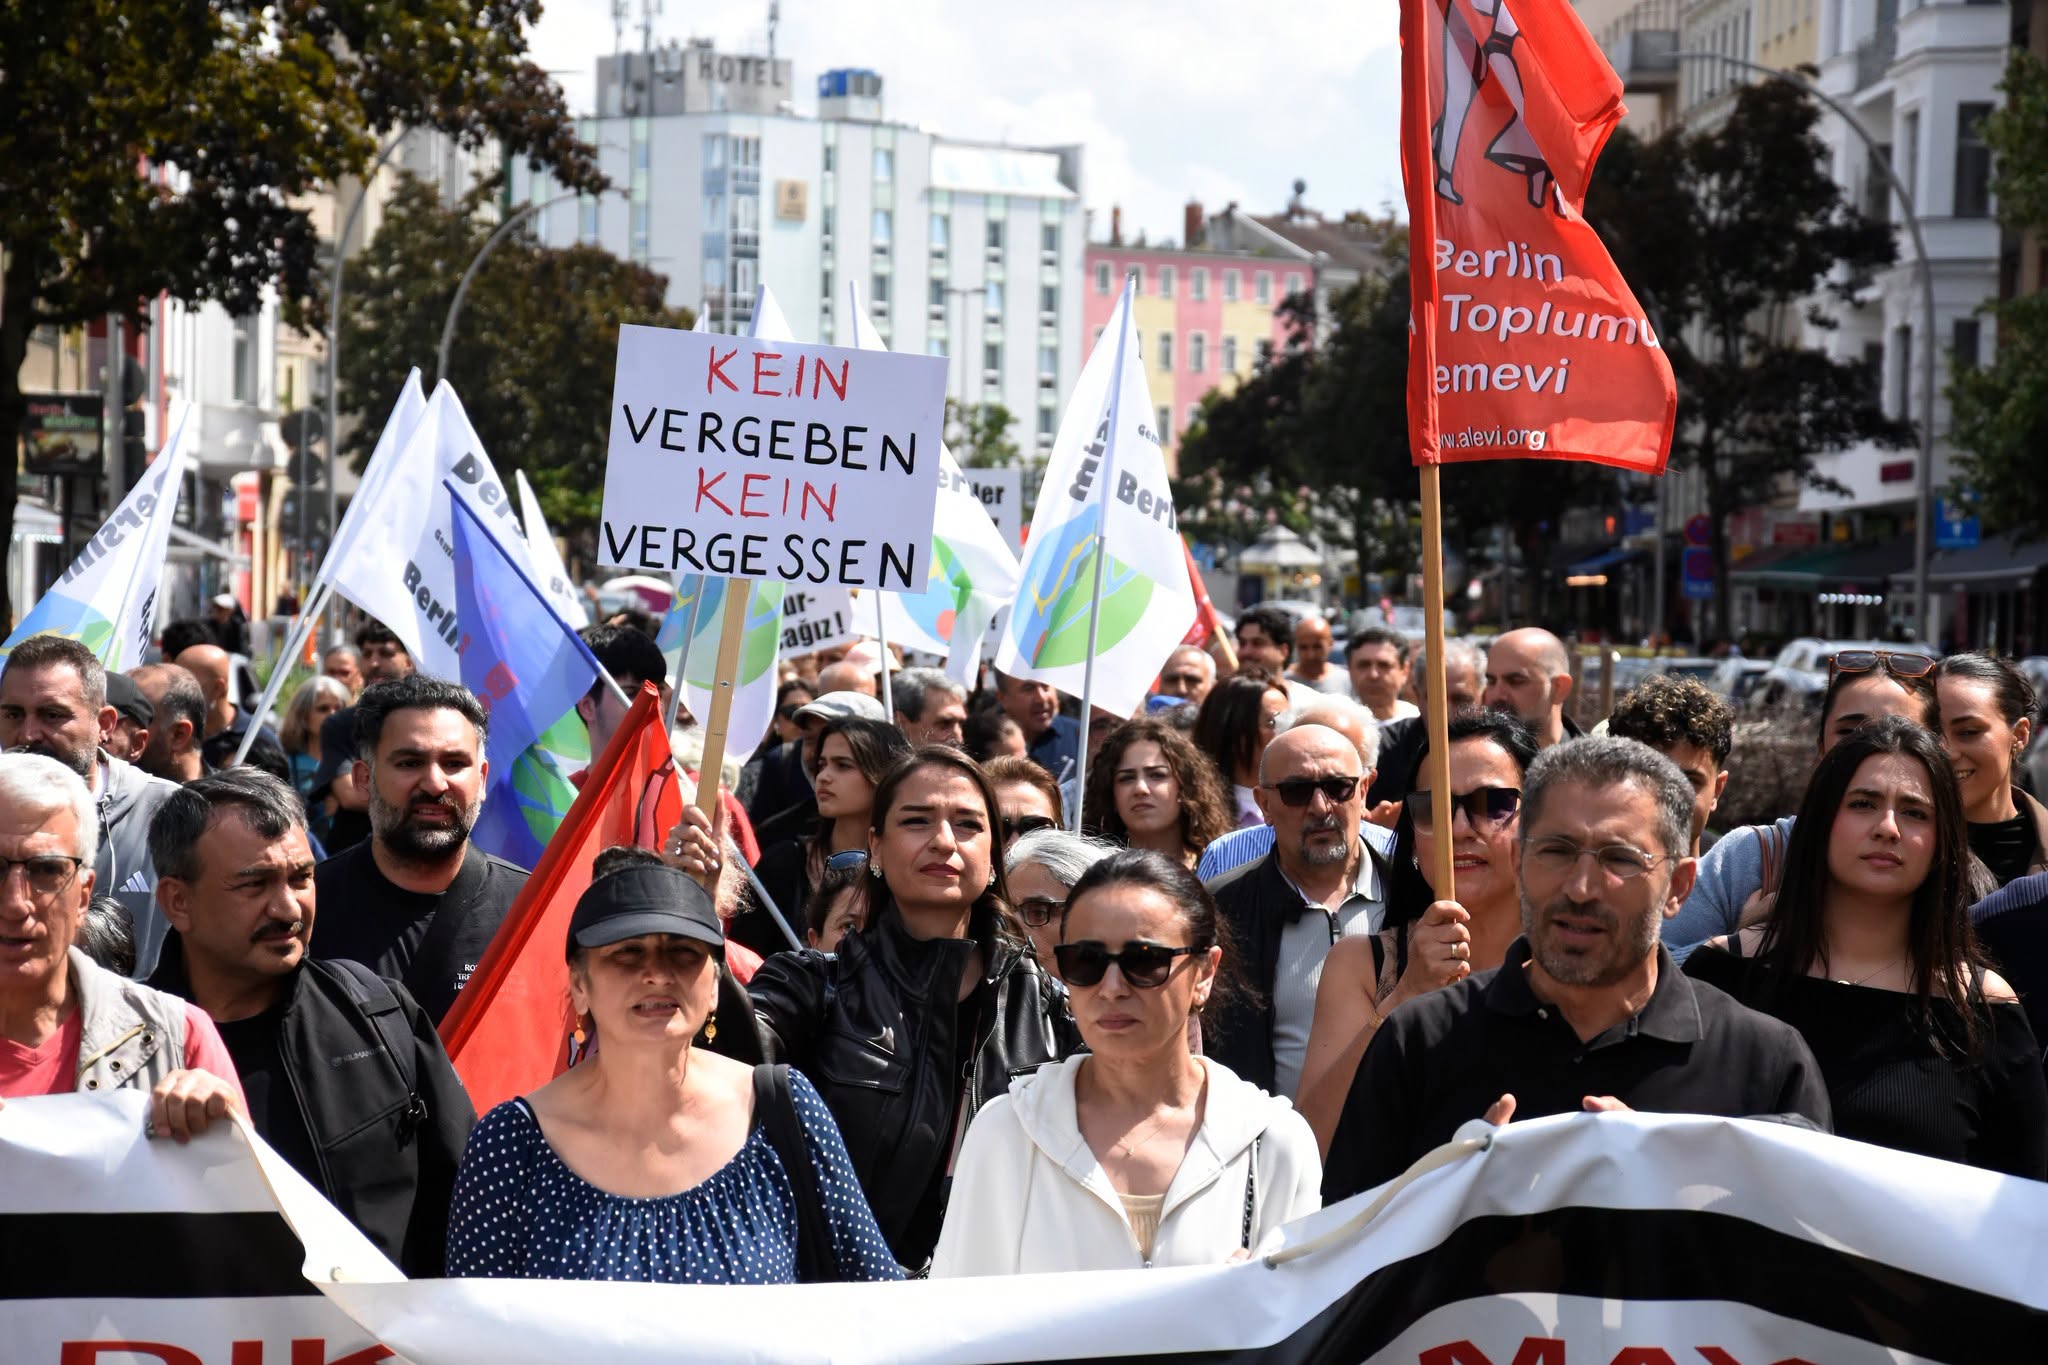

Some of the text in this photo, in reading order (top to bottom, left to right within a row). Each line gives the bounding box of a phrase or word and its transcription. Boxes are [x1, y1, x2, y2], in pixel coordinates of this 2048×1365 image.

[699, 55, 782, 86] HOTEL
[1435, 239, 1563, 282] Berlin
[1442, 294, 1661, 349] Toplumu
[707, 345, 849, 401] KEIN
[623, 404, 916, 475] VERGEBEN
[694, 467, 837, 522] KEIN
[604, 521, 915, 588] VERGESSEN
